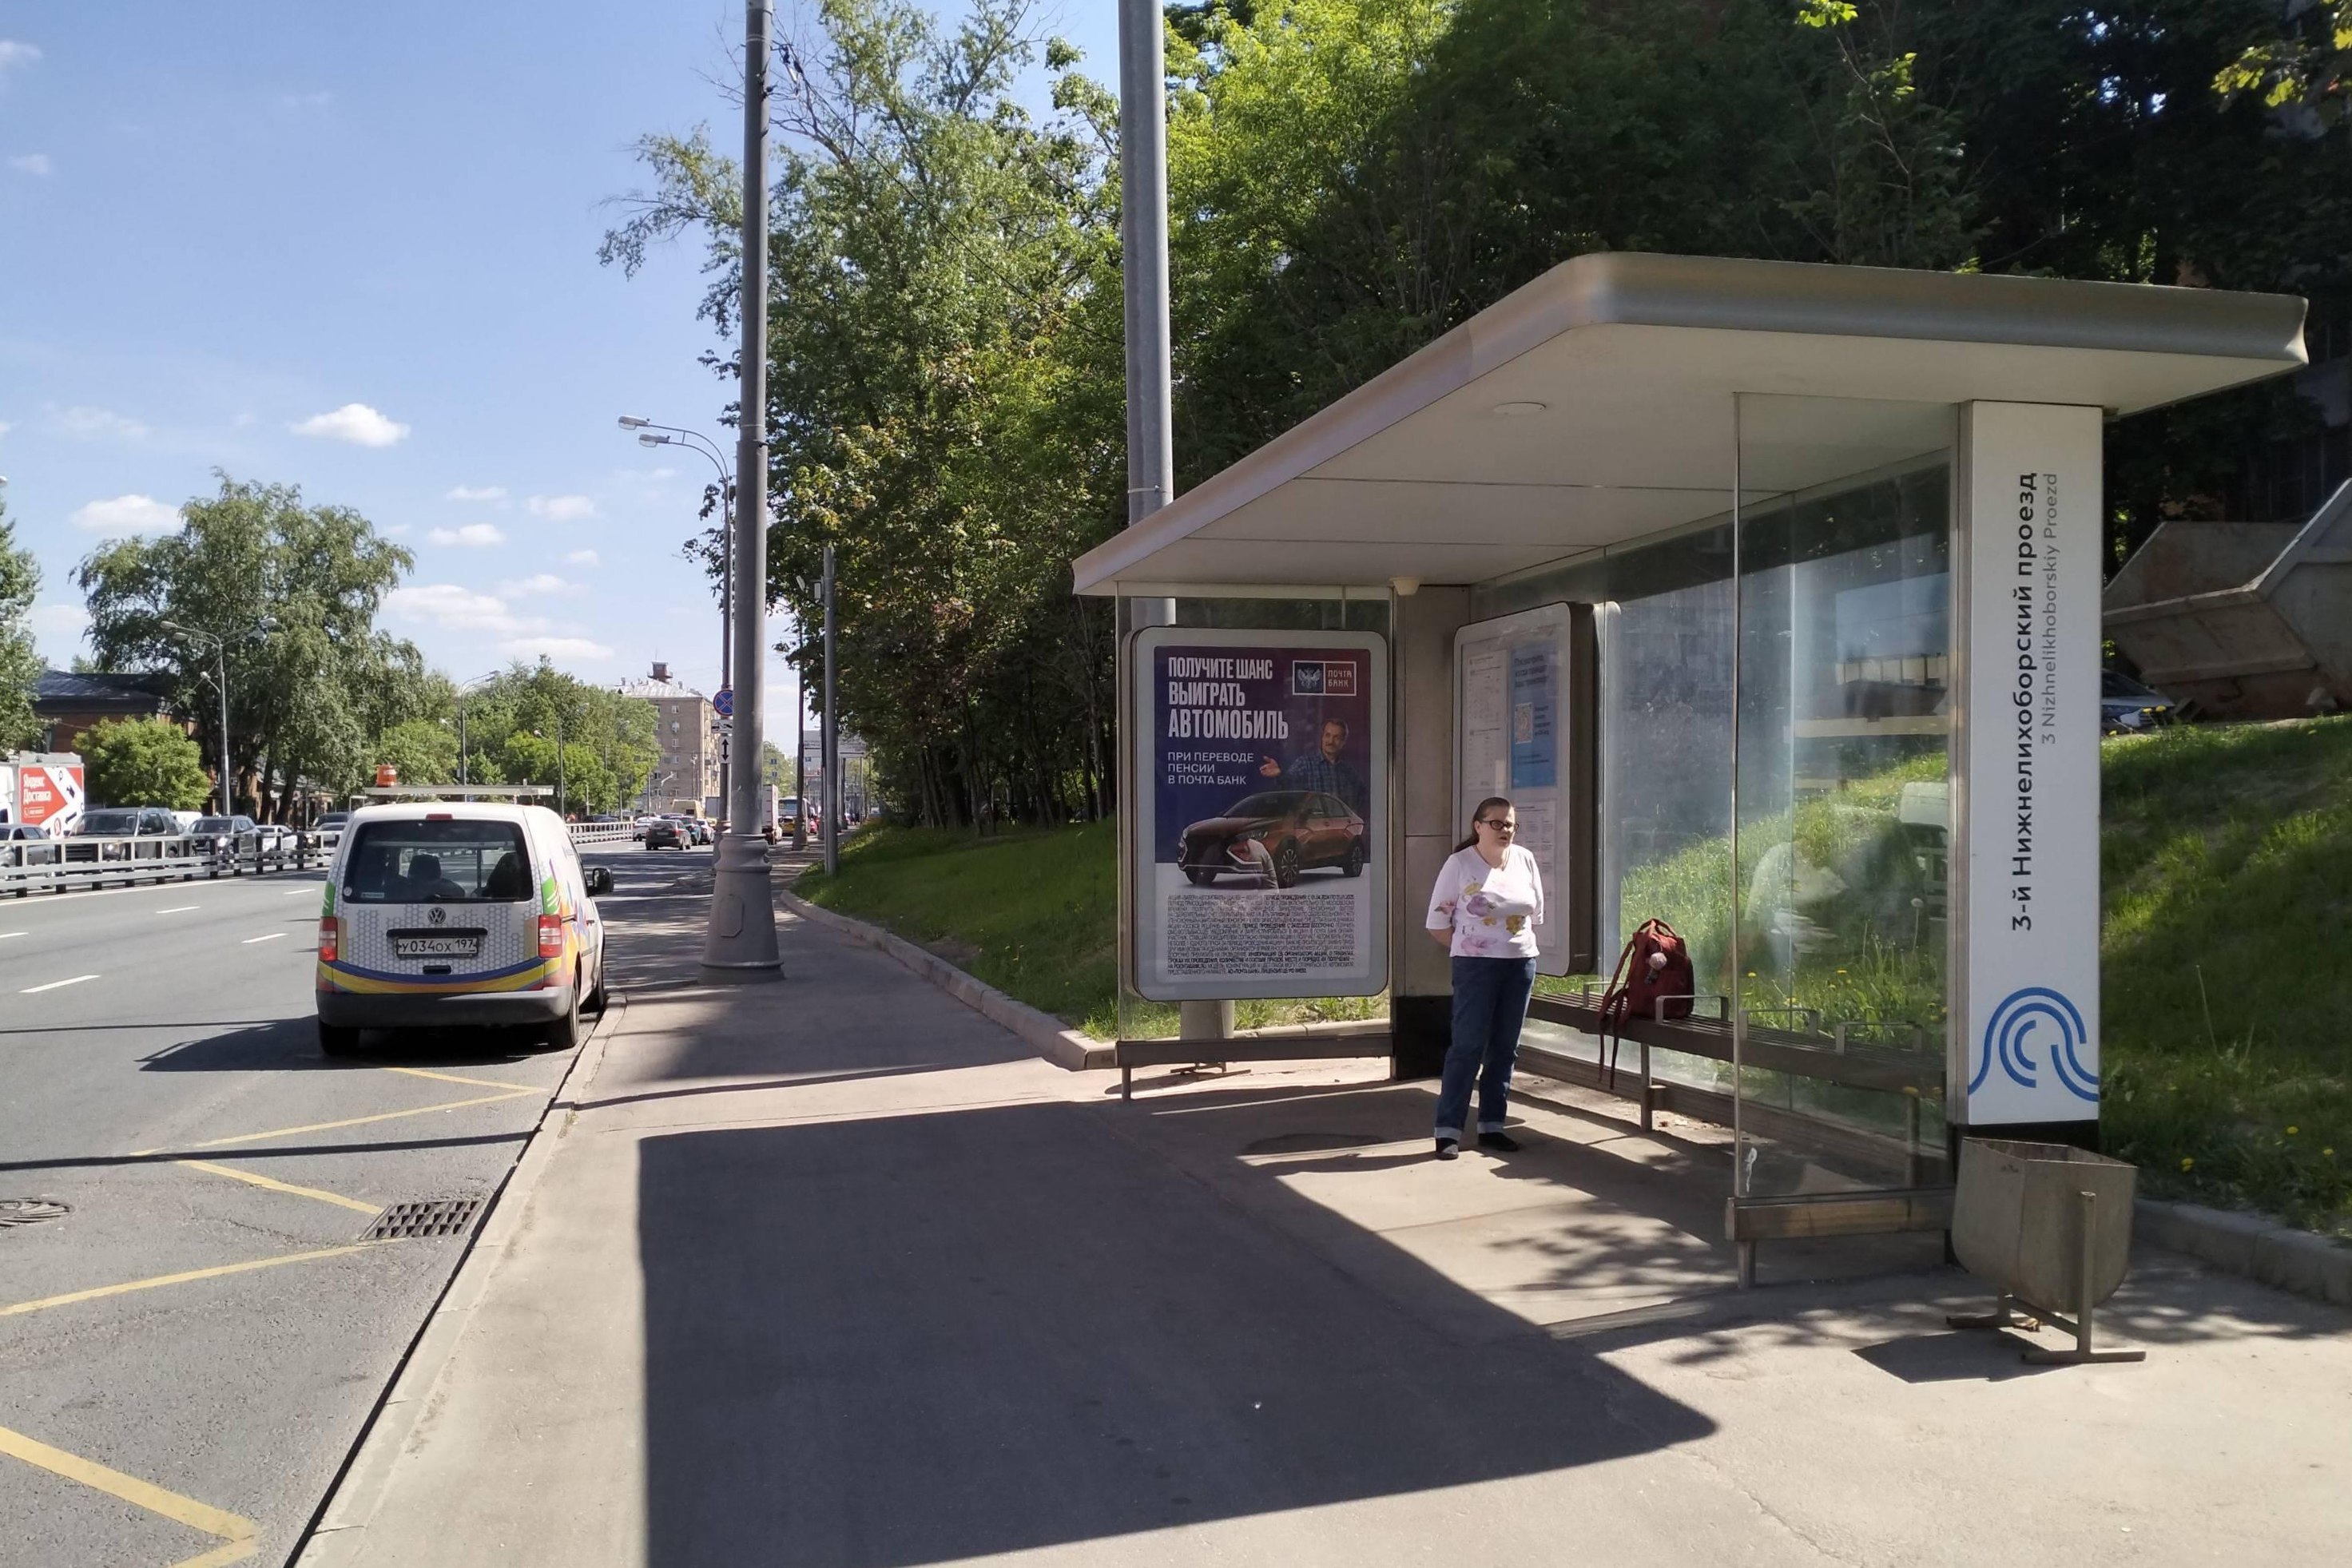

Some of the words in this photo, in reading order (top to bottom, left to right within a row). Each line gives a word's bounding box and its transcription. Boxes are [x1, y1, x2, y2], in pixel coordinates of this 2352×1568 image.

[2042, 473, 2057, 539] Proezd
[2018, 472, 2037, 576] проезд
[2042, 545, 2060, 727] Nizhnelikhoborskiy
[1168, 657, 1234, 679] ПОЛУЧИТЕ
[1236, 659, 1273, 680] ШАНС
[1328, 669, 1353, 678] ПОЧТА
[1168, 681, 1246, 707] ВЫИГРАТЬ
[1328, 678, 1349, 688] БАНК
[1168, 709, 1289, 740] АВТОМОБИЛЬ
[2012, 586, 2036, 876] Нижнелихоборский
[2041, 732, 2056, 744] 3
[1168, 752, 1191, 762] ПРИ
[1194, 752, 1254, 763] ПЕРЕВОДЕ
[1168, 764, 1215, 773] ПЕНСИИ
[1168, 775, 1175, 784] В
[1178, 775, 1214, 784] ПОЧТА
[1217, 776, 1246, 785] БАНК
[2012, 887, 2032, 931] 3-й
[455, 939, 473, 948] 197
